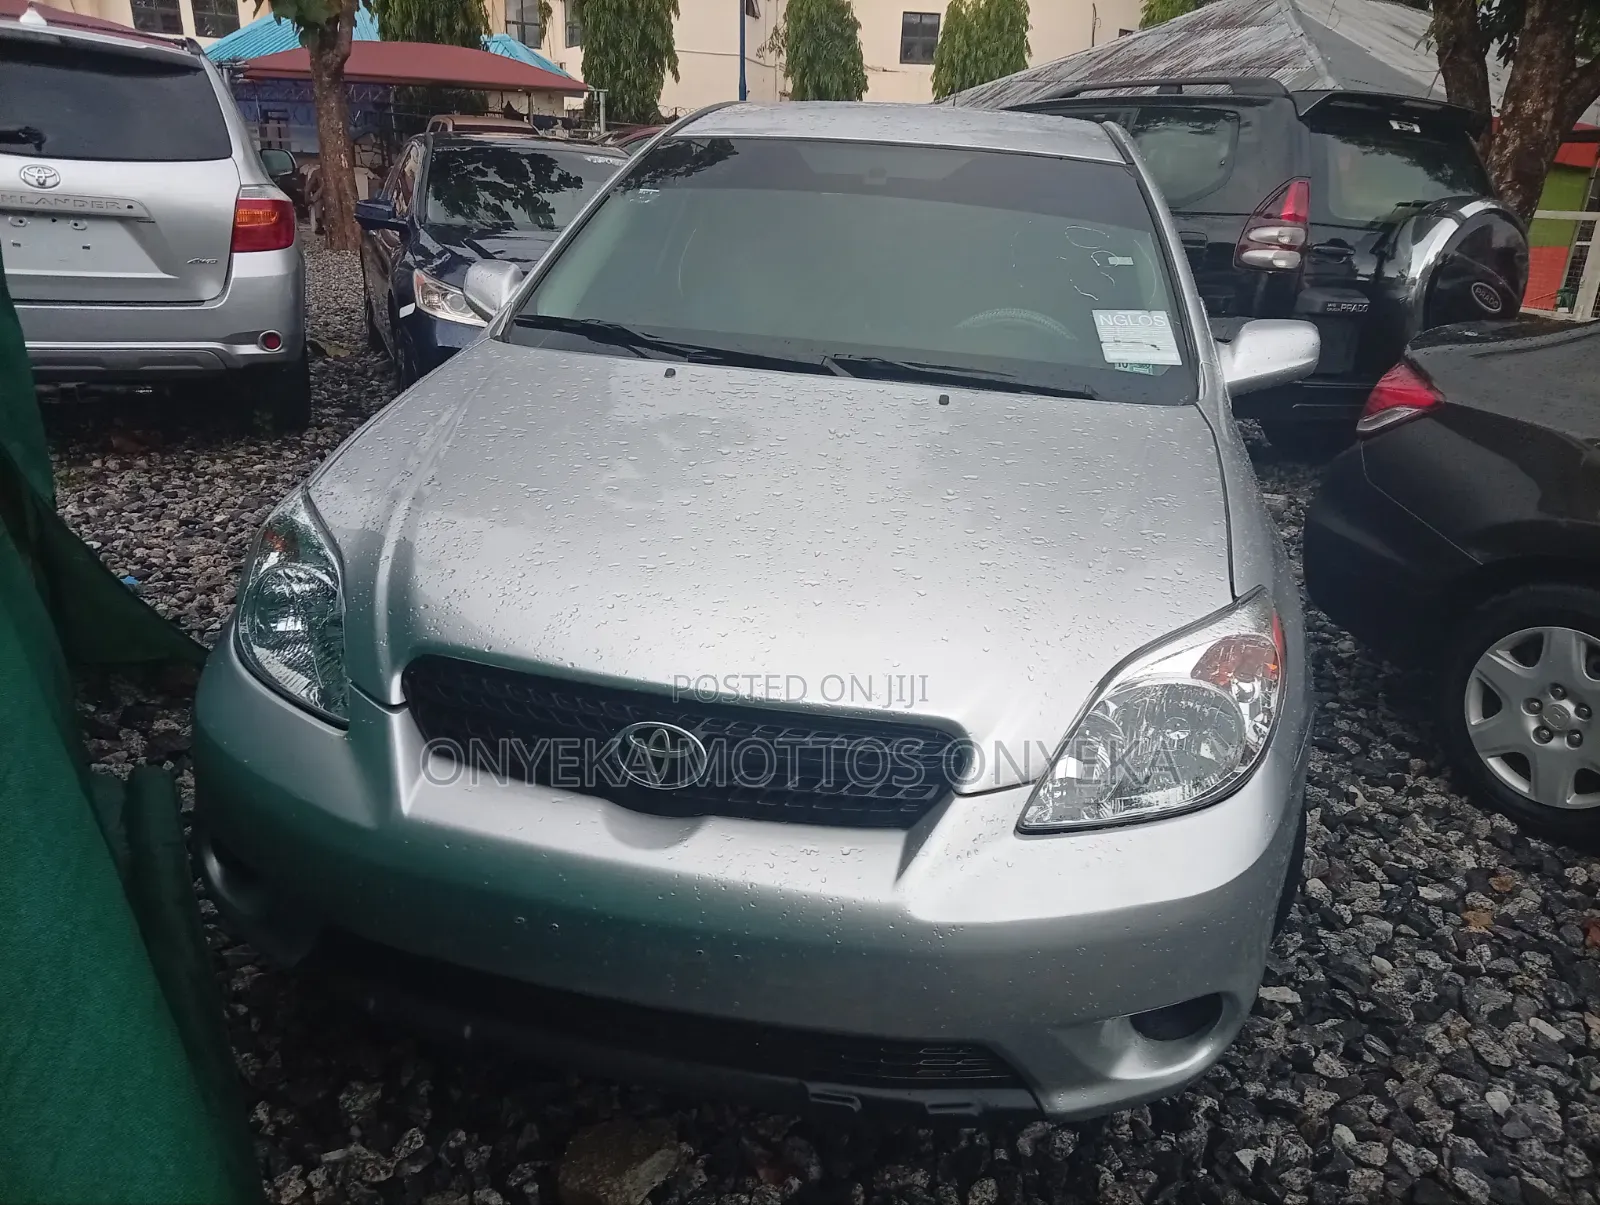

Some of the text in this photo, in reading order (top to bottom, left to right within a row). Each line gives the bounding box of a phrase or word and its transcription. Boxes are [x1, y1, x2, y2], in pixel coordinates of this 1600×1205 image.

[1475, 287, 1499, 308] PRADO
[1340, 303, 1369, 312] PRADO
[1099, 314, 1166, 327] NGLOS
